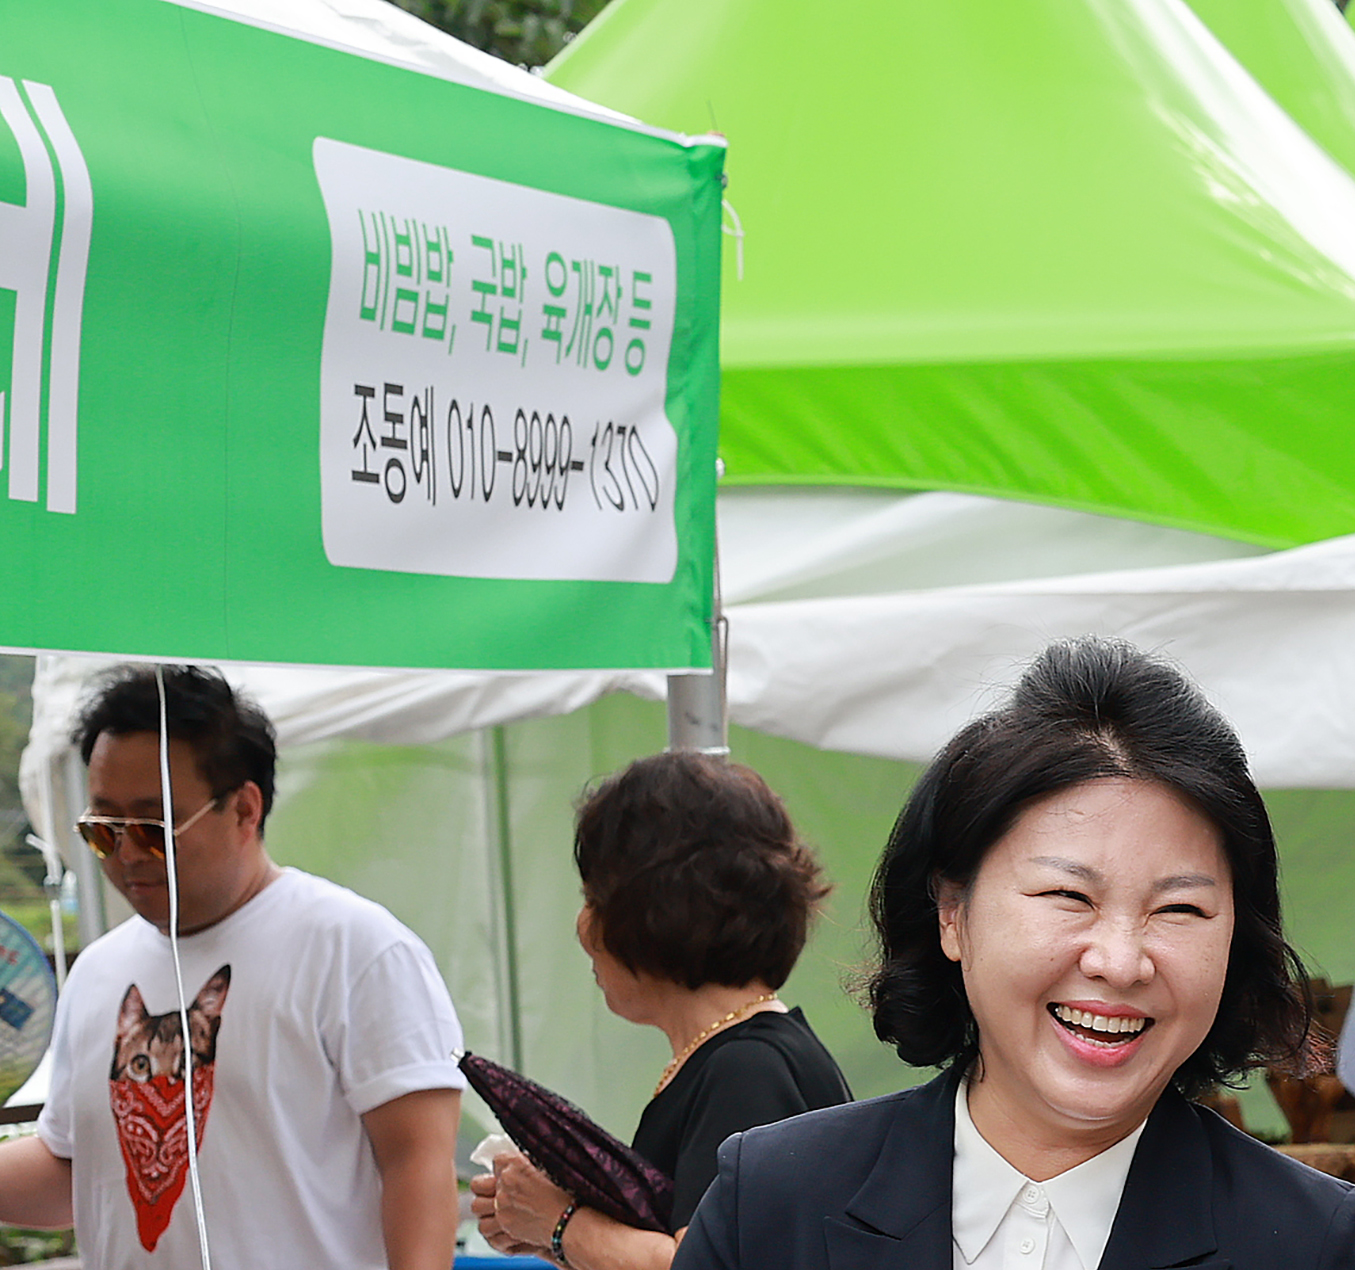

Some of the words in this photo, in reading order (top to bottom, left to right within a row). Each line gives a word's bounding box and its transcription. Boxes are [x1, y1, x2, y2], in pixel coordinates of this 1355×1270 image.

[358, 208, 457, 356] 비빔밥,
[470, 232, 528, 369] 국밥,
[542, 250, 623, 372] 육개장
[623, 270, 654, 377] 등
[351, 382, 437, 507] 조동예
[447, 398, 660, 513] 010-8999-1370
